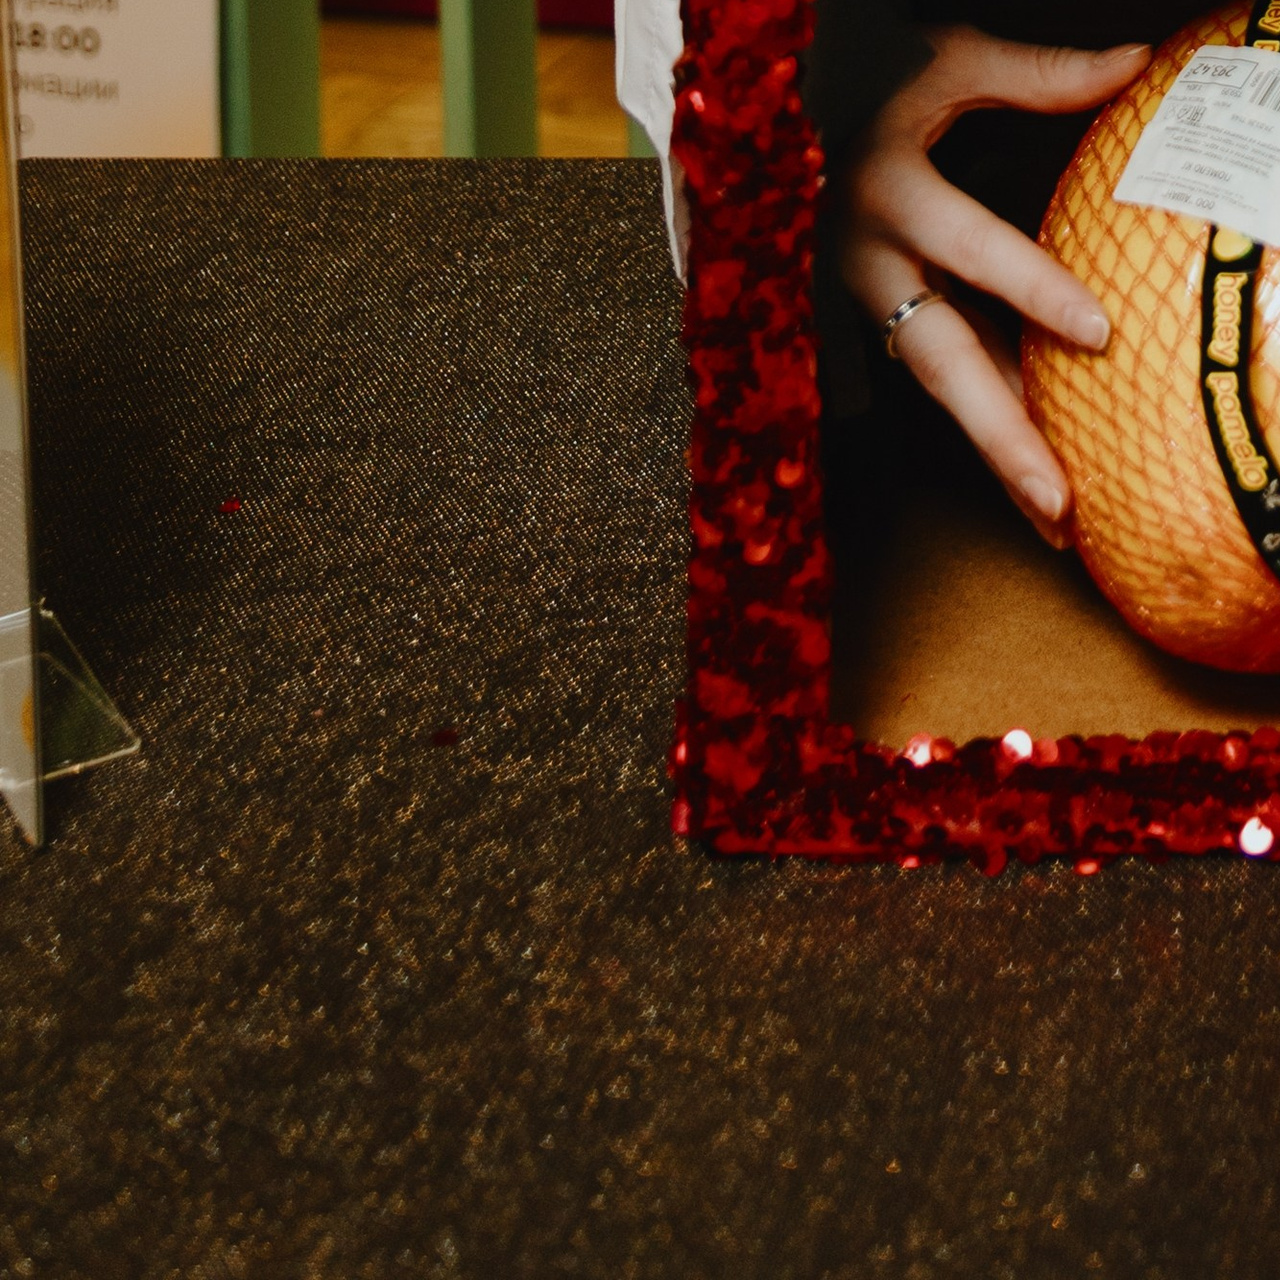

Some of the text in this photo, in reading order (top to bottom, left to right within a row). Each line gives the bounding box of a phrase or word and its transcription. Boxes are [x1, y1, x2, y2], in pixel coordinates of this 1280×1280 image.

[1192, 62, 1238, 78] 293.42
[1193, 163, 1233, 182] ПОМЕЛО
[1207, 272, 1248, 367] honey
[1206, 371, 1269, 491] pomelo
